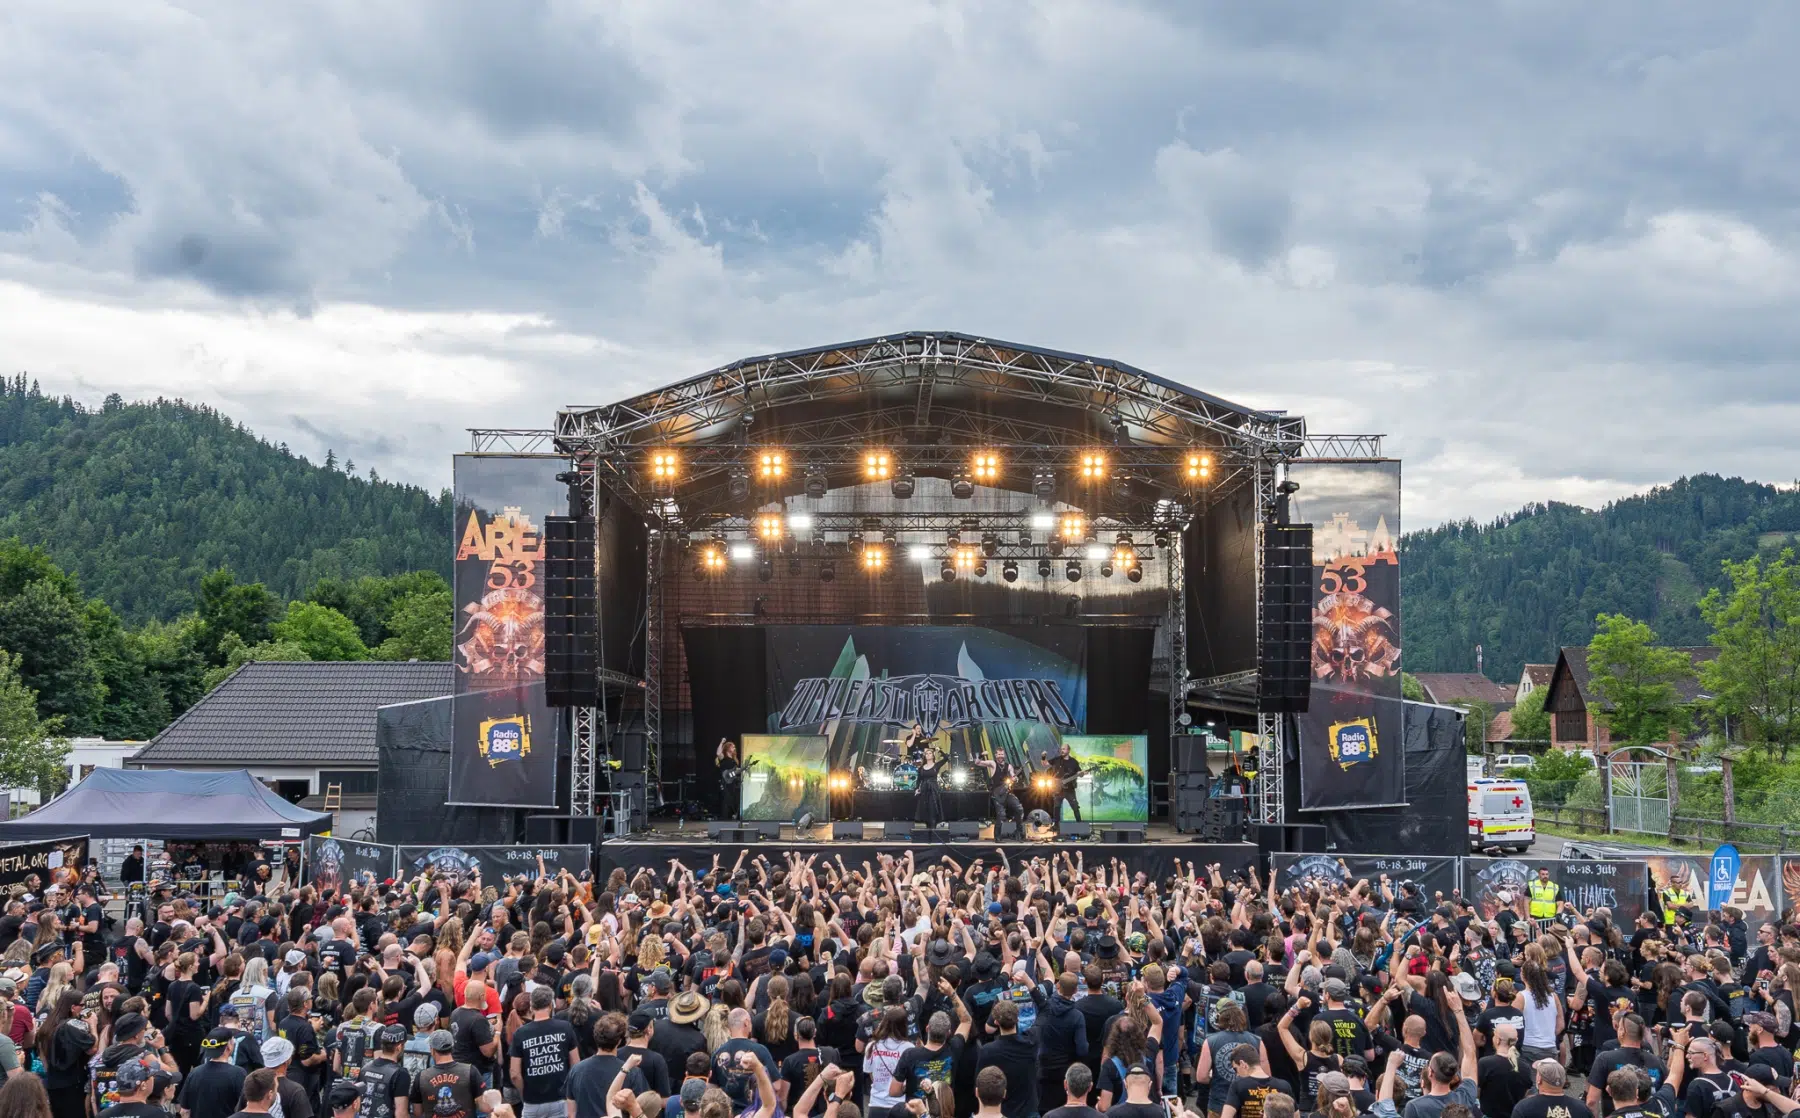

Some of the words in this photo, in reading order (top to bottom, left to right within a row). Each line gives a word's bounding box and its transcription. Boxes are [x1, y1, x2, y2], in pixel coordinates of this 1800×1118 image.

[456, 506, 545, 560] ARE
[1312, 511, 1398, 565] REA
[487, 558, 536, 589] 53
[1320, 563, 1367, 595] 53
[779, 677, 910, 730] UNLEASH
[919, 690, 938, 711] THE
[947, 678, 1078, 729] ARCHERS
[493, 729, 519, 739] Radio
[1341, 732, 1366, 742] Radio
[1689, 868, 1775, 911] AEA
[522, 1032, 566, 1050] HELLENIC
[529, 1043, 561, 1058] BLACK
[526, 1062, 564, 1077] LEGIONS
[529, 1053, 562, 1067] METAL
